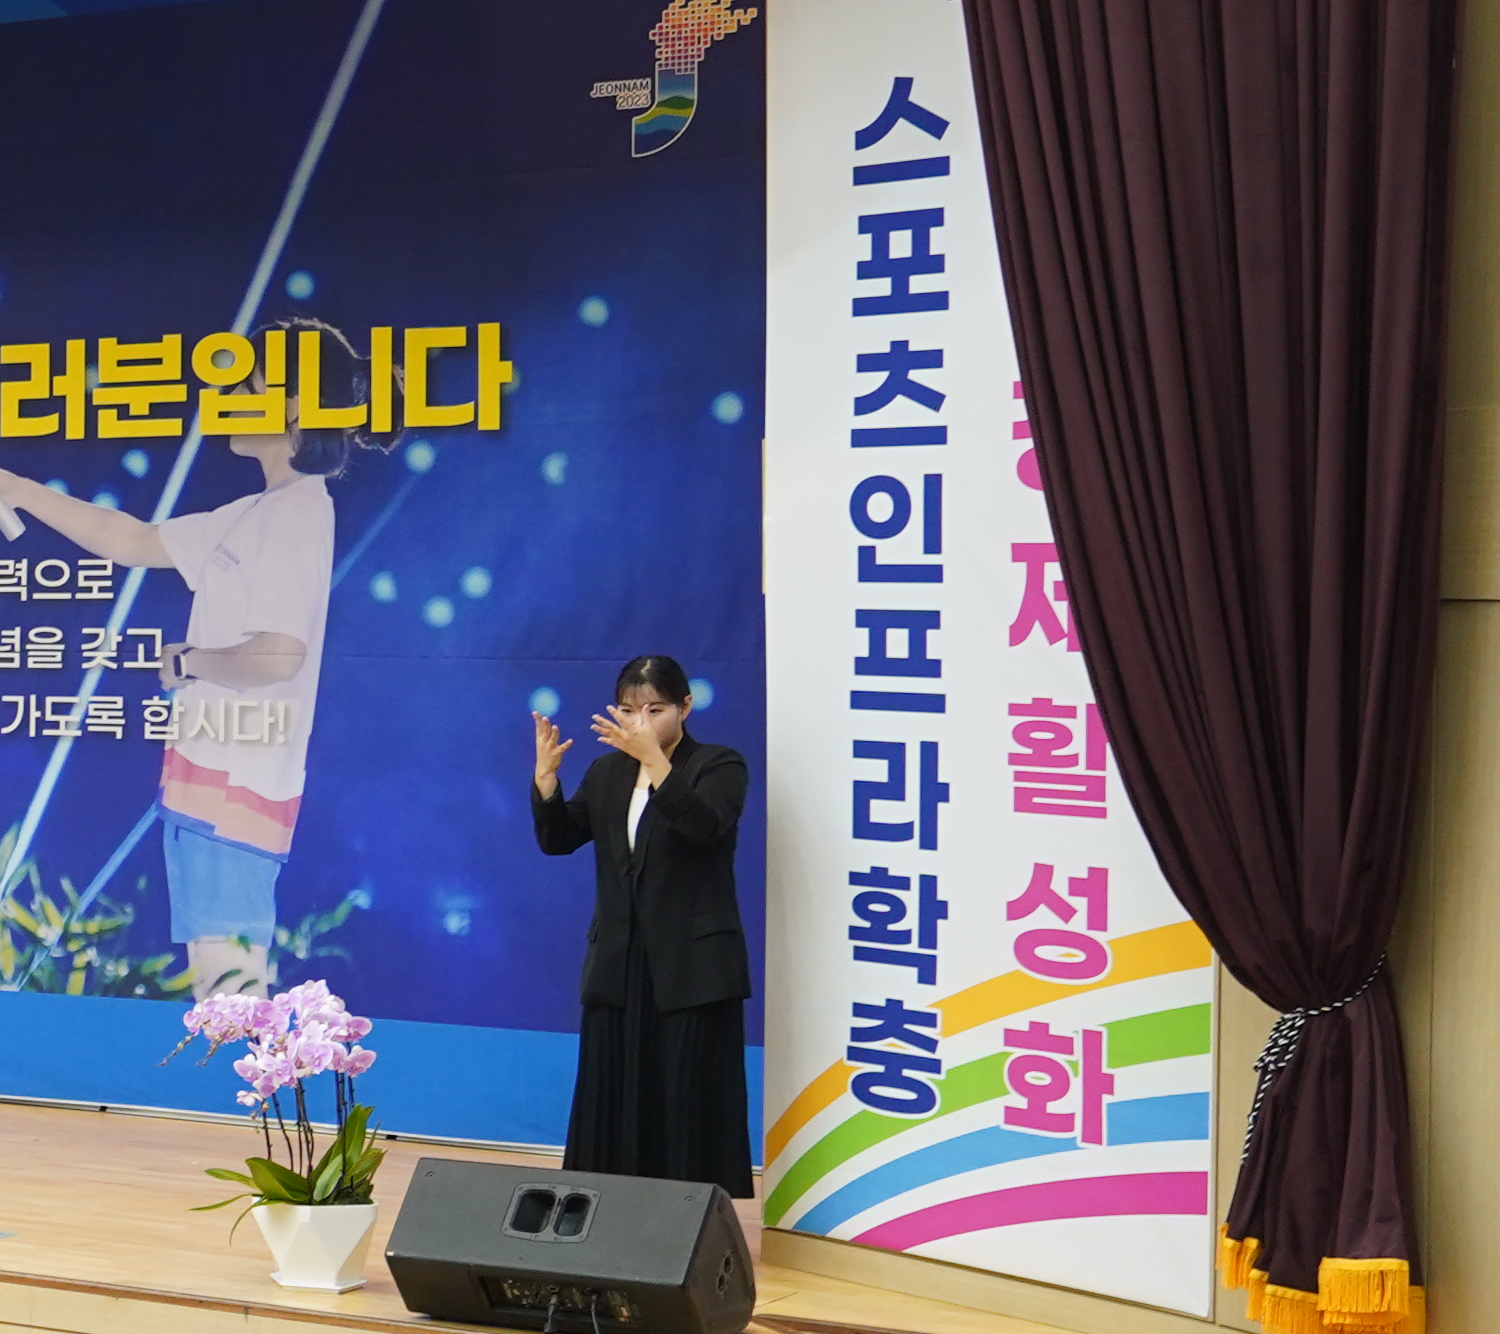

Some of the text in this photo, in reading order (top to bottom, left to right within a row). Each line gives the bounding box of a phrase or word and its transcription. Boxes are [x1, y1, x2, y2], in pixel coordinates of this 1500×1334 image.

[591, 80, 649, 96] JEONNAM
[618, 94, 649, 108] 2023
[847, 75, 951, 1117] 스포츠인프라확충
[80, 627, 165, 670] 갖고
[0, 694, 126, 739] 가도록
[142, 697, 287, 744] 합시다!
